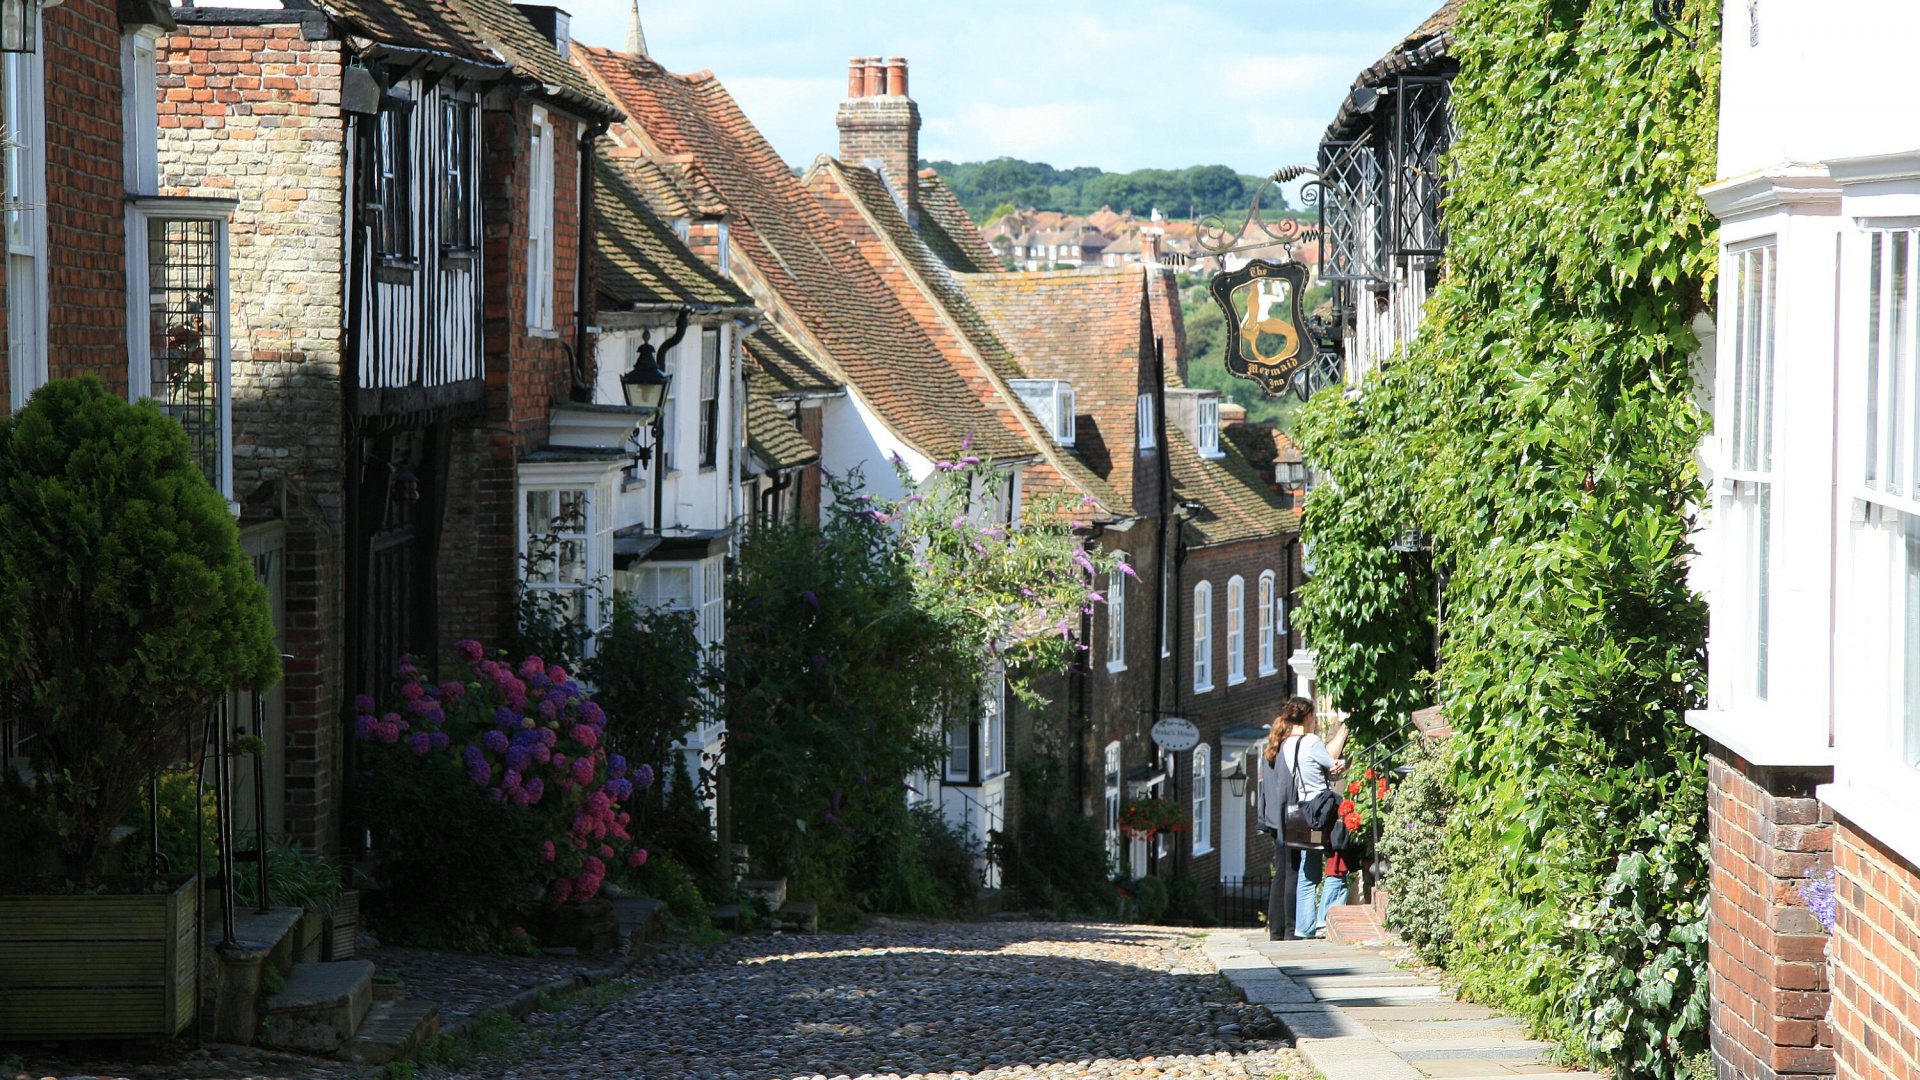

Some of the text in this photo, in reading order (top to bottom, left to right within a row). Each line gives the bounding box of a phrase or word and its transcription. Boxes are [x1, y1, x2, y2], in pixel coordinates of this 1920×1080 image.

[1249, 267, 1267, 277] The
[1247, 358, 1298, 375] Mermaid
[1268, 379, 1284, 390] Inn
